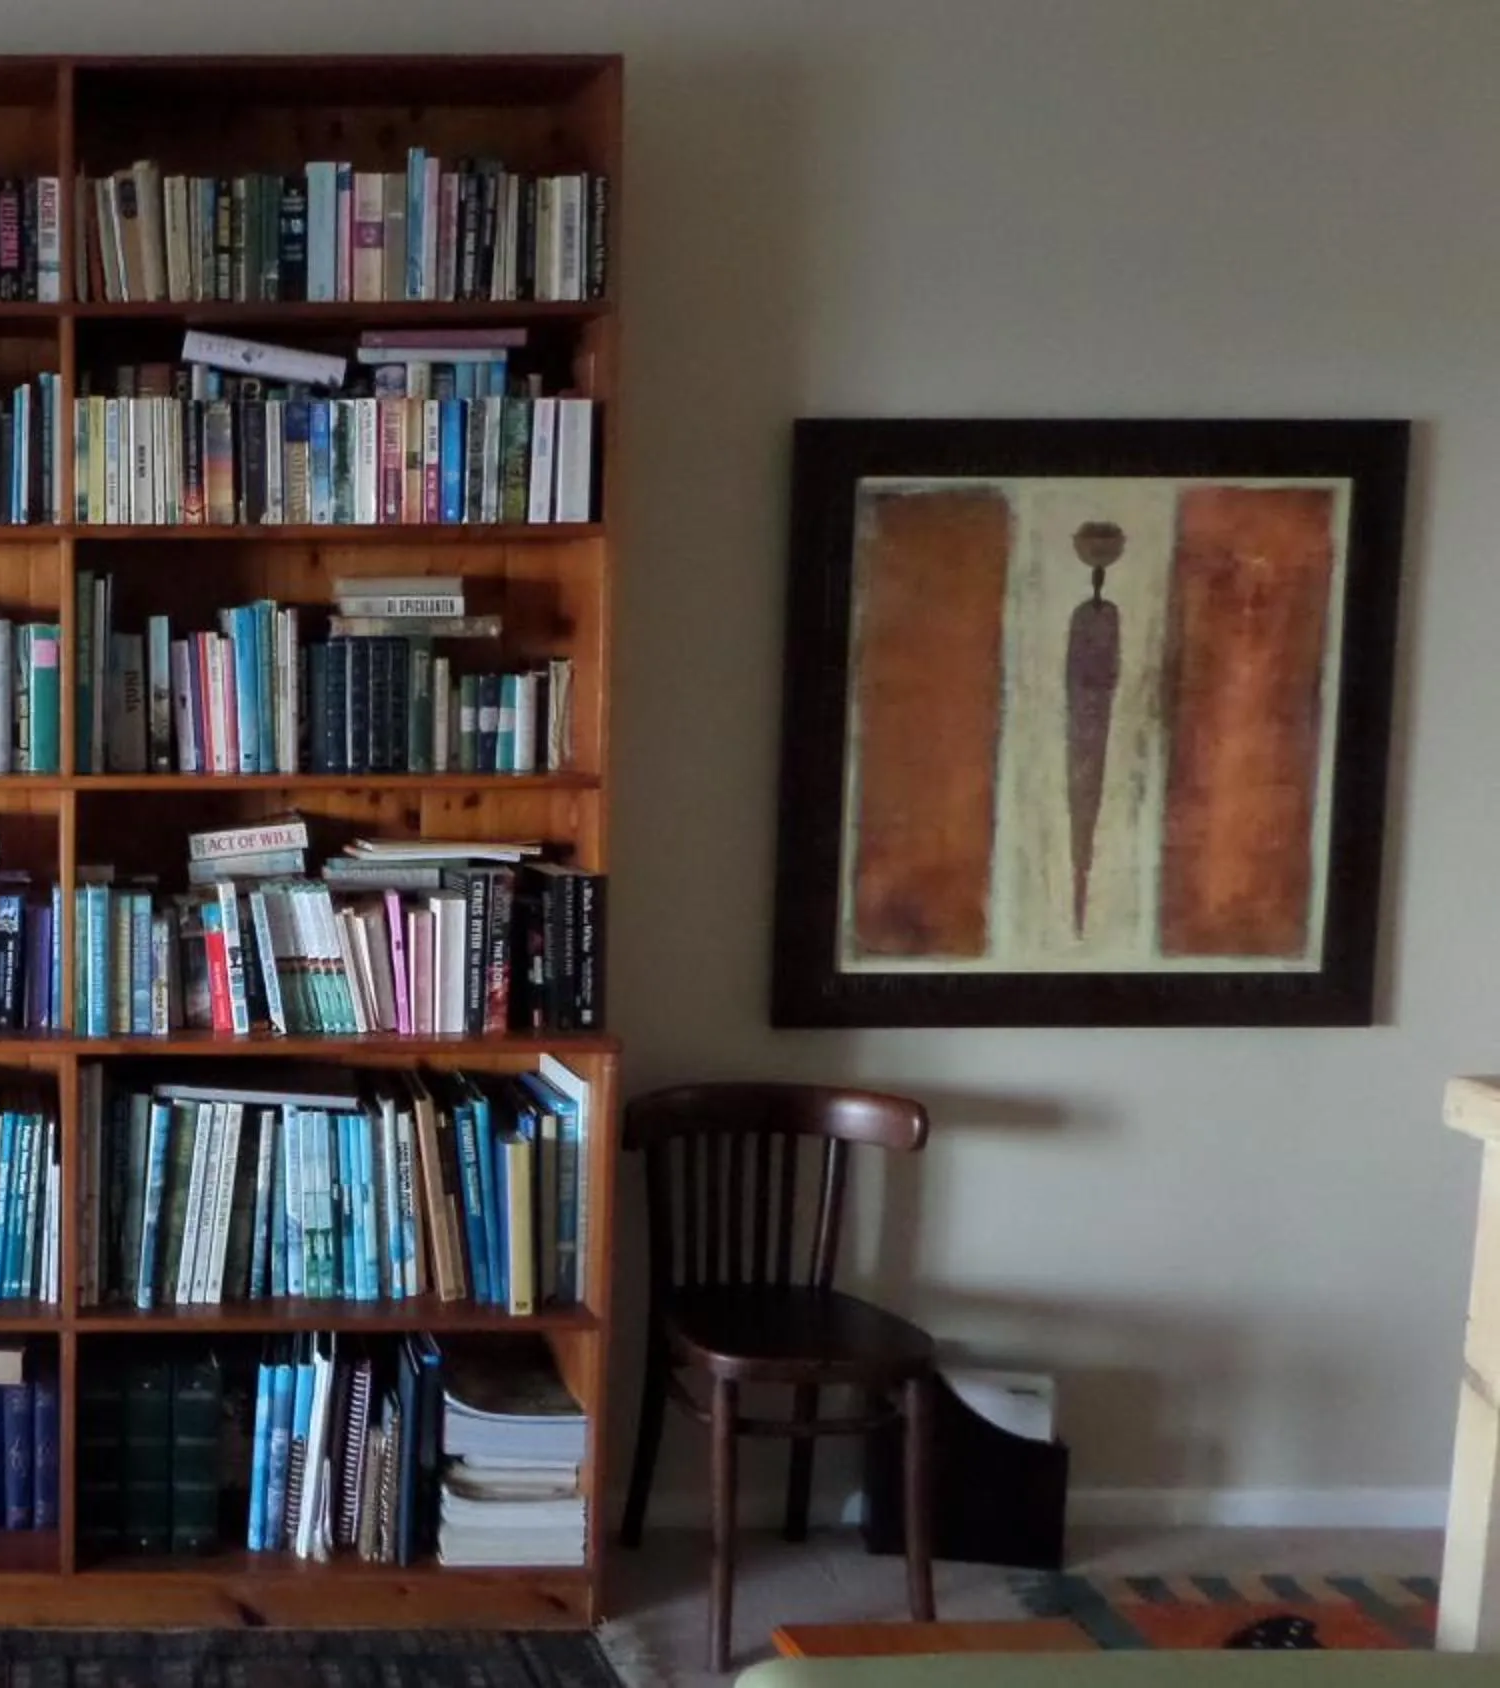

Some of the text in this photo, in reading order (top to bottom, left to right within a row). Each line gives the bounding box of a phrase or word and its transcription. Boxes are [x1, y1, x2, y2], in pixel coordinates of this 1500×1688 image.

[209, 835, 234, 851] ACT
[238, 834, 253, 849] OF
[259, 830, 293, 847] WILL
[471, 881, 483, 916] CHRIS
[471, 919, 483, 949] RYAN
